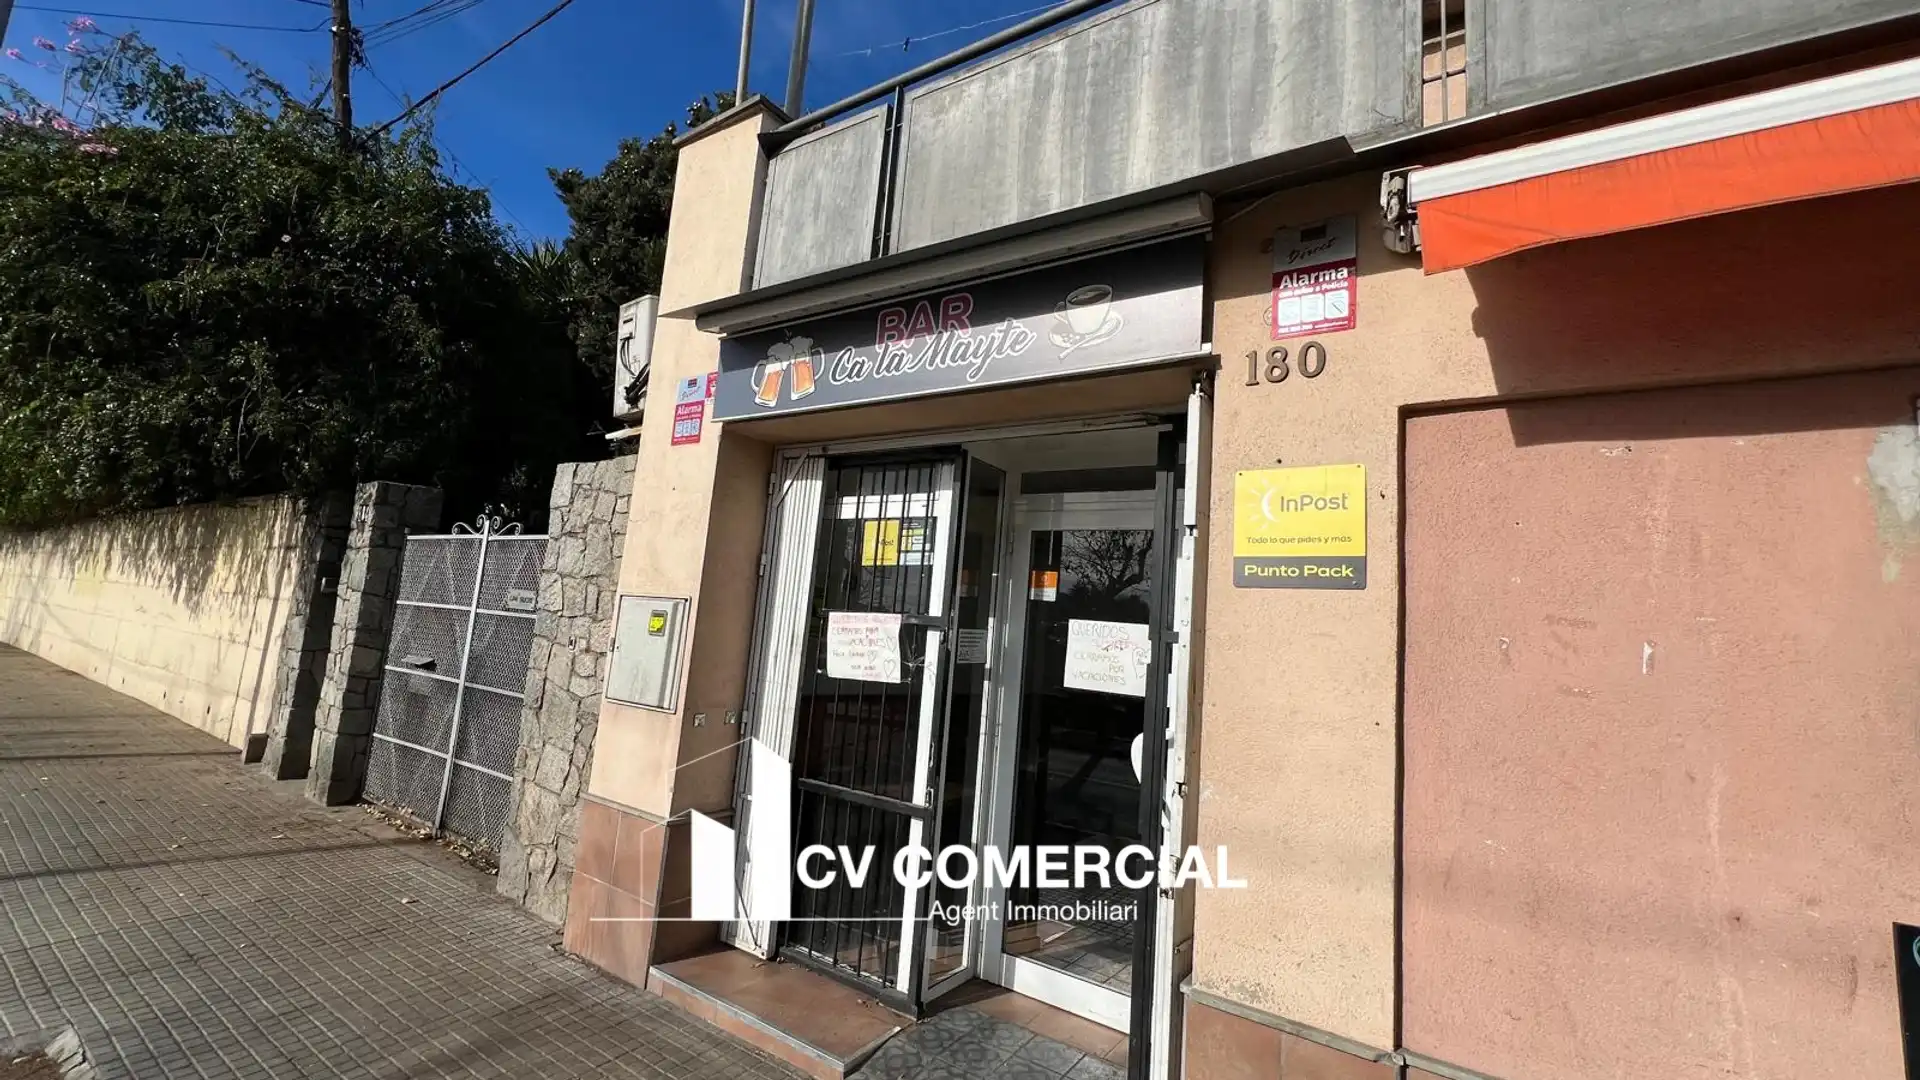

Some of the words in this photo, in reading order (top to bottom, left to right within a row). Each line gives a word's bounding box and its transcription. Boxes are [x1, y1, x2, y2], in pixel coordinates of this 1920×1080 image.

[1280, 266, 1348, 290] Alarma
[876, 293, 973, 349] BAR
[829, 346, 872, 384] Ca
[873, 340, 910, 378] la
[906, 317, 1037, 381] Mayte
[1245, 341, 1327, 386] 180
[1280, 493, 1348, 512] InPost
[1247, 536, 1268, 544] Todo
[1297, 536, 1322, 544] pides
[1244, 565, 1299, 577] Punto
[1304, 565, 1353, 577] Pack
[1072, 621, 1130, 640] QUERIDOS
[1072, 670, 1126, 685] VACACIONES
